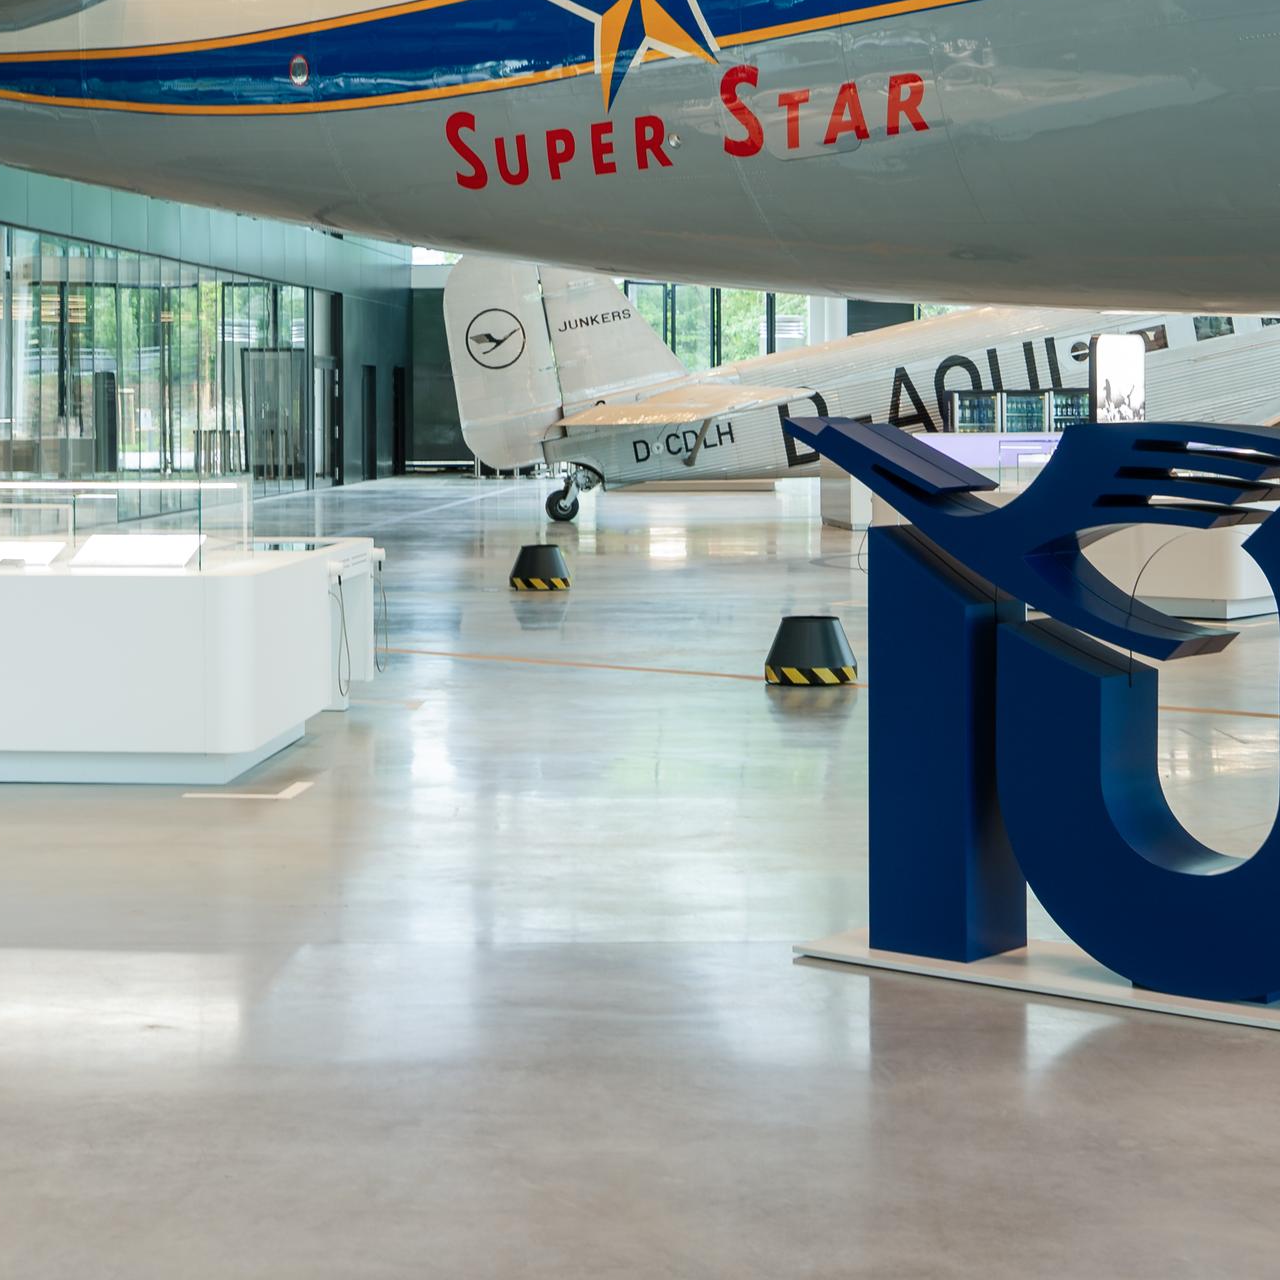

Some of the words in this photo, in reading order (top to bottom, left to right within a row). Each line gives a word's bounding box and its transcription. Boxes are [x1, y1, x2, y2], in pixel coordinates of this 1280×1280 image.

[445, 111, 674, 190] SUPER
[719, 65, 932, 158] STAR
[558, 308, 632, 333] JUNKERS
